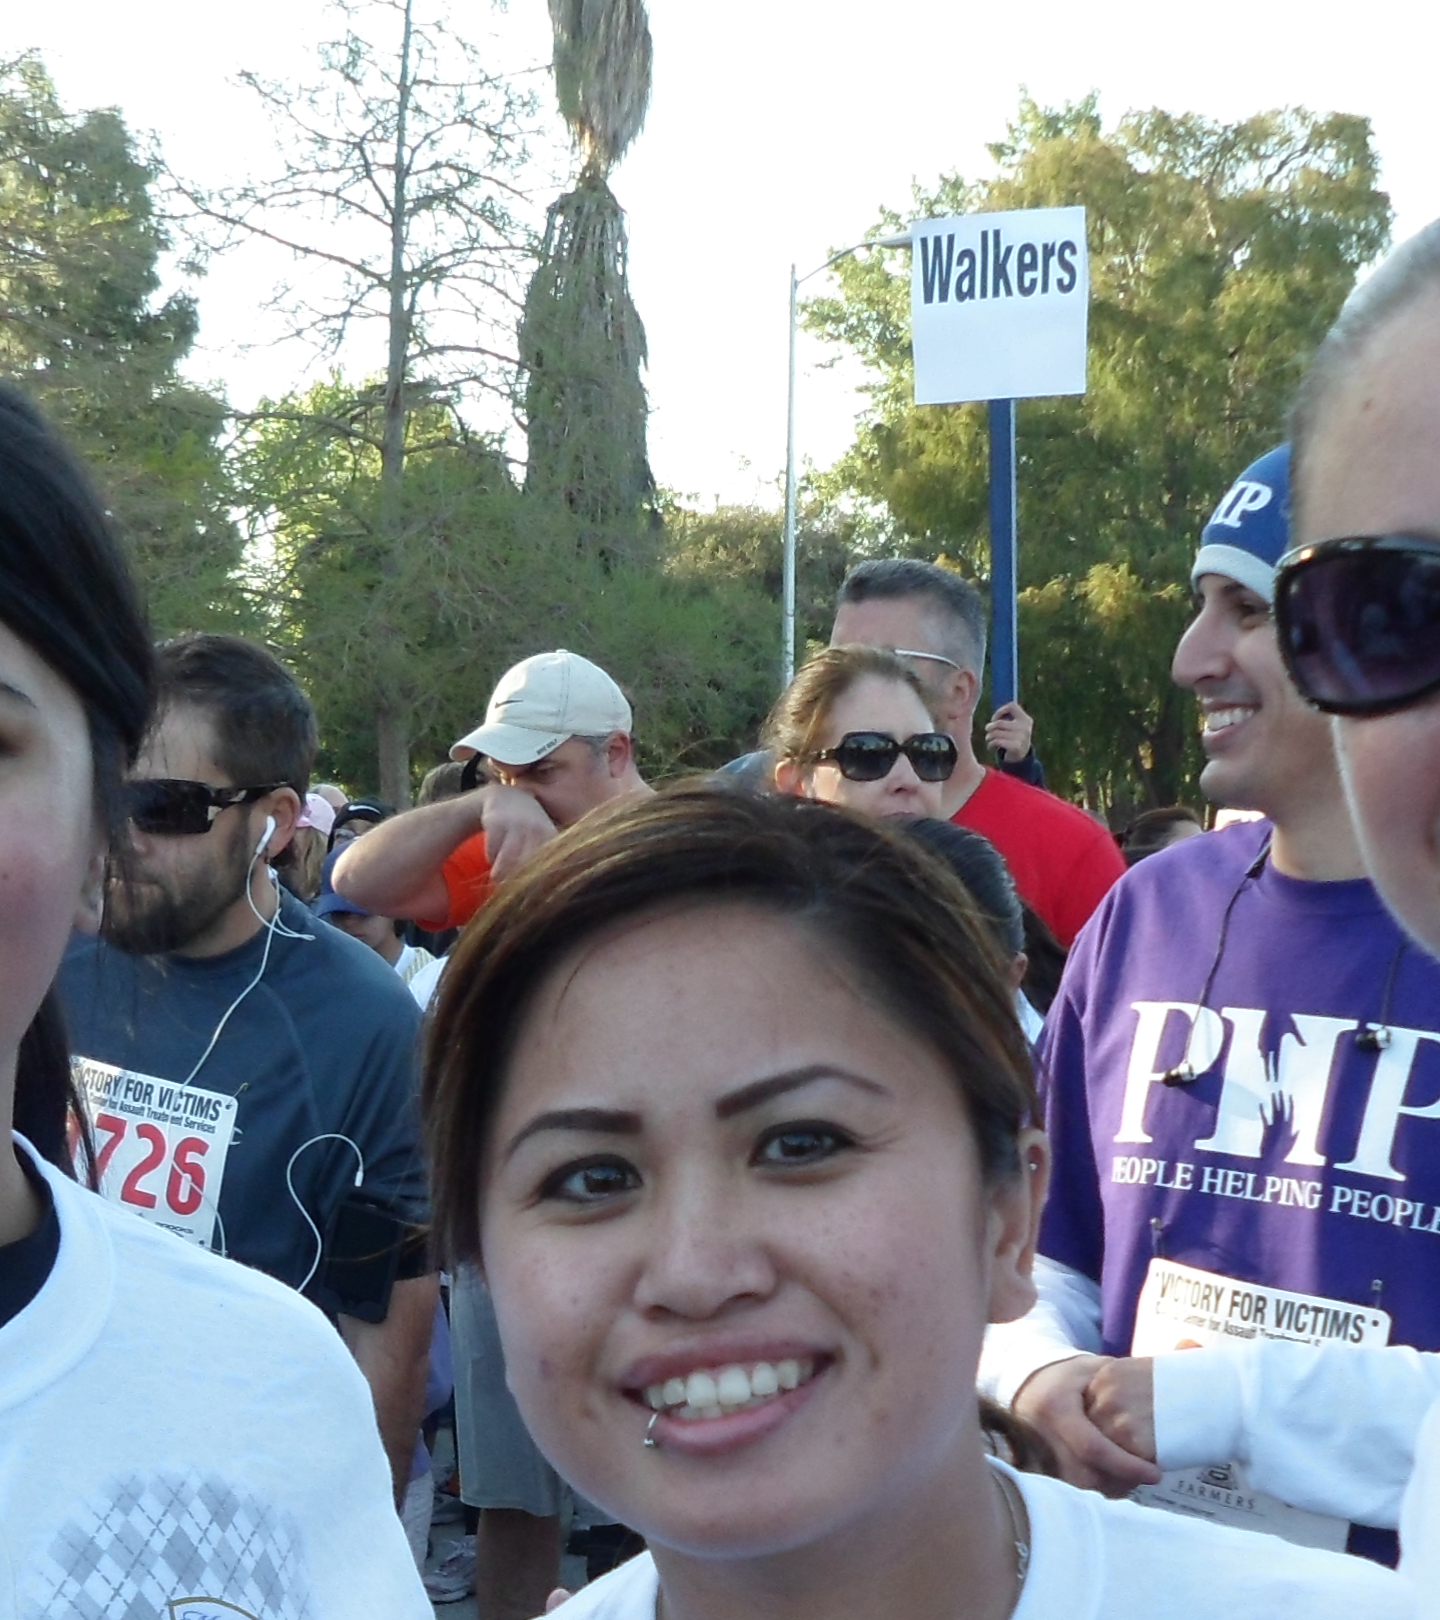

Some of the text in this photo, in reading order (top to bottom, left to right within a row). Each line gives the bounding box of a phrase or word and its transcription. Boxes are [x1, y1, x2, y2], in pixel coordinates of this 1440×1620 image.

[920, 229, 1077, 305] Walkers
[81, 1066, 223, 1122] CTORY FOR VICTIMS
[1200, 1166, 1323, 1208] HELPING
[1228, 1289, 1267, 1325] FOR
[1274, 1298, 1366, 1344] VICTIMS
[1177, 1480, 1255, 1510] FARMERS
